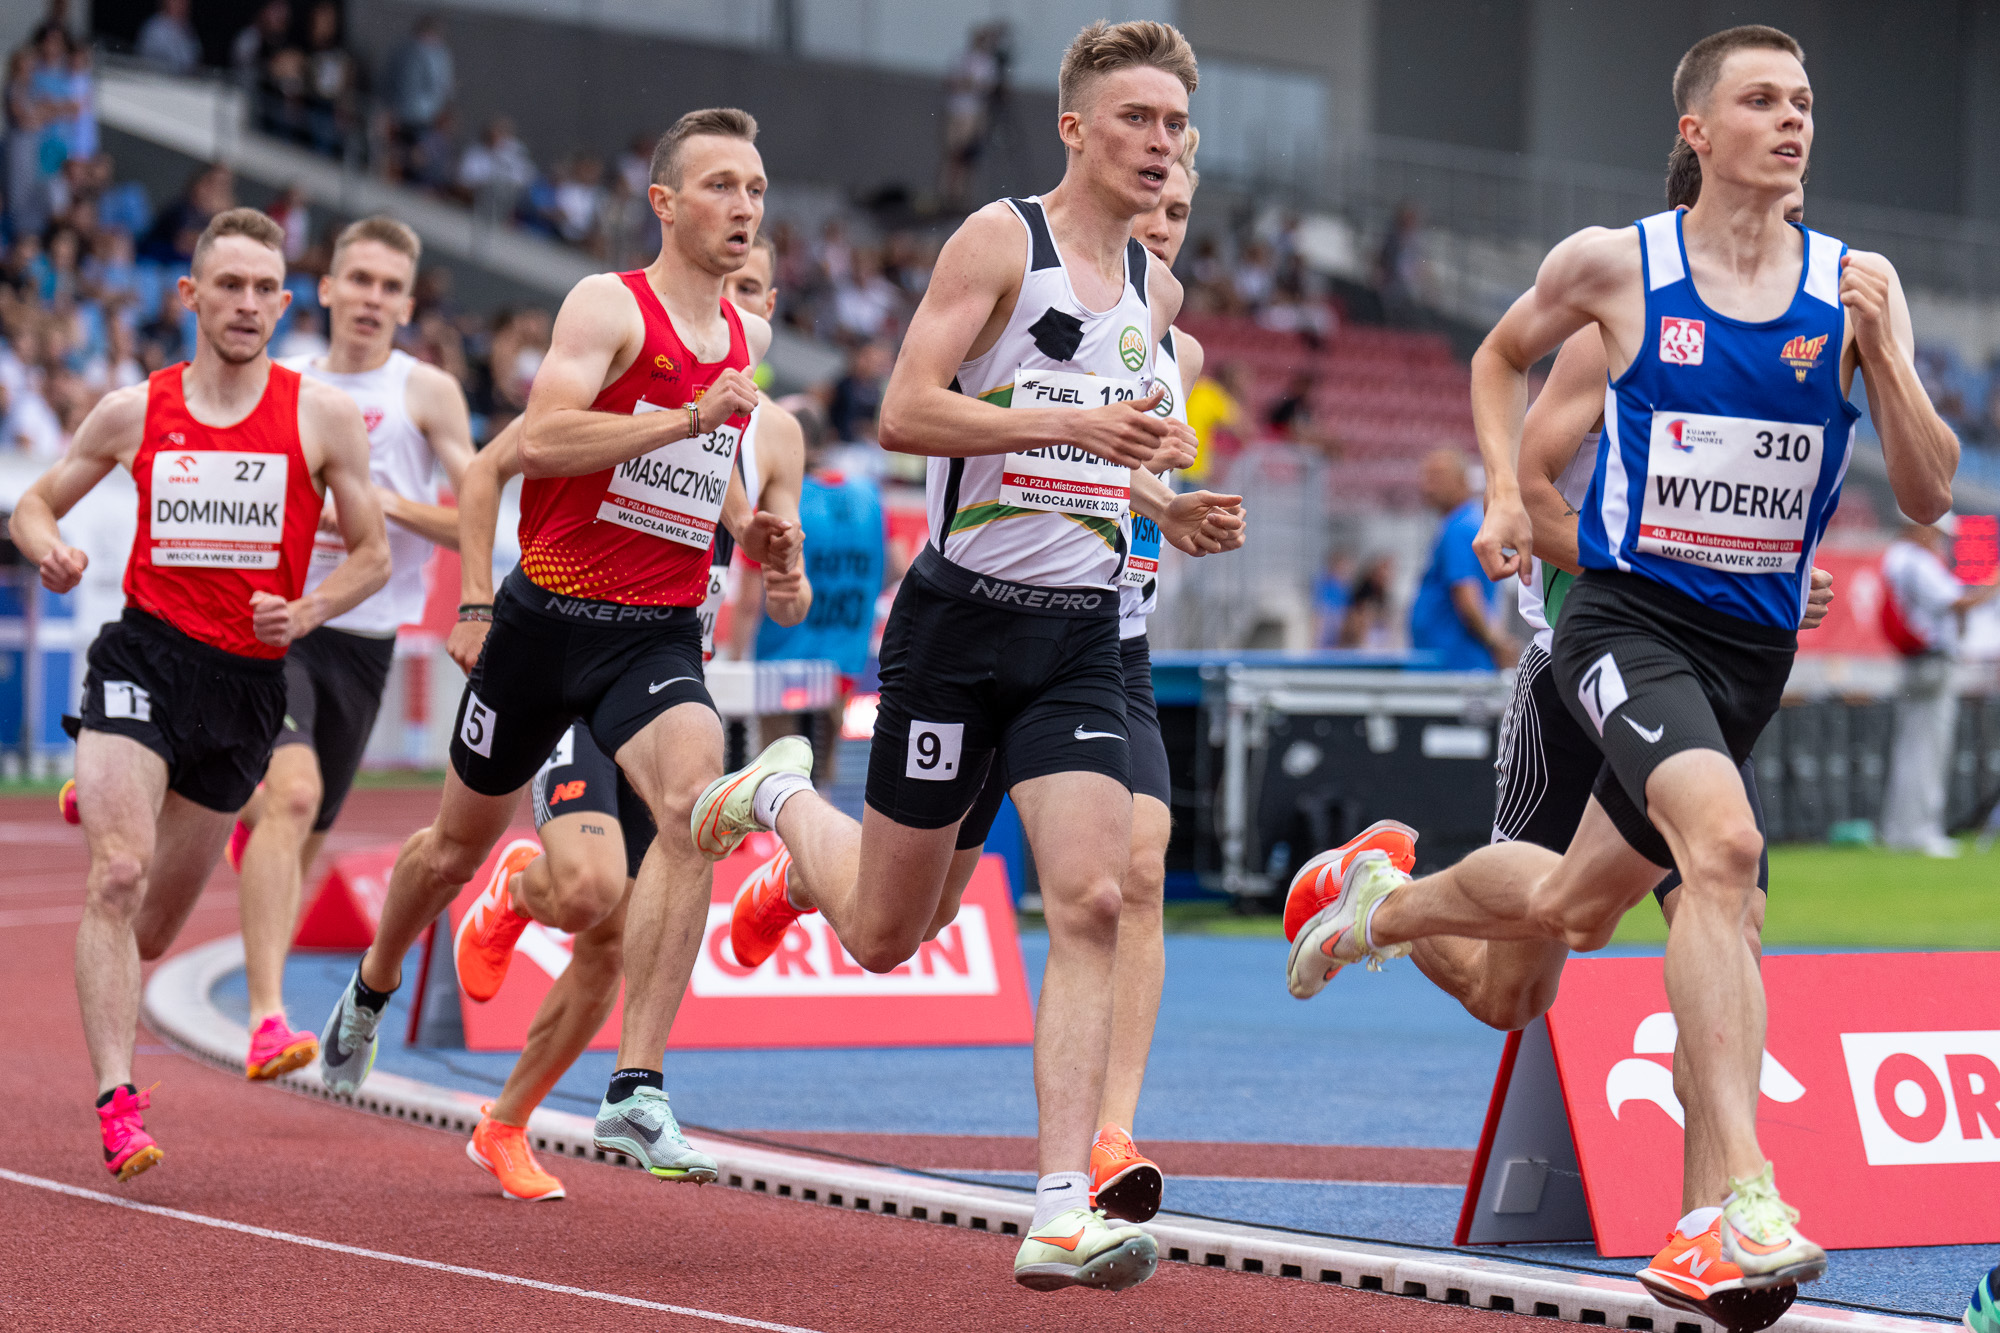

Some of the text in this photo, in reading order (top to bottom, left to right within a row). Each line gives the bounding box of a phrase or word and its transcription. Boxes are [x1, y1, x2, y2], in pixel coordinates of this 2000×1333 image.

[1123, 333, 1143, 352] RKS
[1781, 333, 1829, 360] AWF
[1036, 386, 1084, 405] FUEL
[702, 430, 734, 458] 323
[1686, 436, 1723, 445] POMORZE
[1753, 430, 1811, 463] 310
[168, 476, 199, 484] ORLEN
[234, 460, 266, 482] 27
[620, 457, 726, 506] MASACZYŃSKI
[1013, 476, 1125, 498] 40. PZLA Mistrzostwa Polski U23
[1656, 475, 1803, 520] WYDERKA
[157, 499, 279, 527] DOMINIAK
[614, 497, 626, 507] 40.
[627, 500, 646, 512] PZLA
[646, 506, 691, 525] Mistrzostwa
[691, 518, 708, 530] Polski
[1021, 491, 1119, 512] WŁOCŁAWEK 2023
[618, 510, 709, 545] WŁOCŁAWEK 2023
[1652, 528, 1794, 551] 40. PZLA Mistrzostwa Polski U23
[238, 554, 263, 564] 2023
[1129, 559, 1144, 569] Polski
[1661, 545, 1782, 568] WŁOCŁAWEK 2023
[1129, 572, 1146, 583] 2023
[969, 578, 1102, 610] NIKE PRO
[545, 596, 673, 621] NIKE PRO
[1582, 666, 1604, 720] 7
[466, 702, 487, 746] 5
[916, 731, 953, 770] 9.
[549, 780, 587, 806] NB
[580, 824, 605, 836] run
[1874, 1052, 2000, 1144] OR
